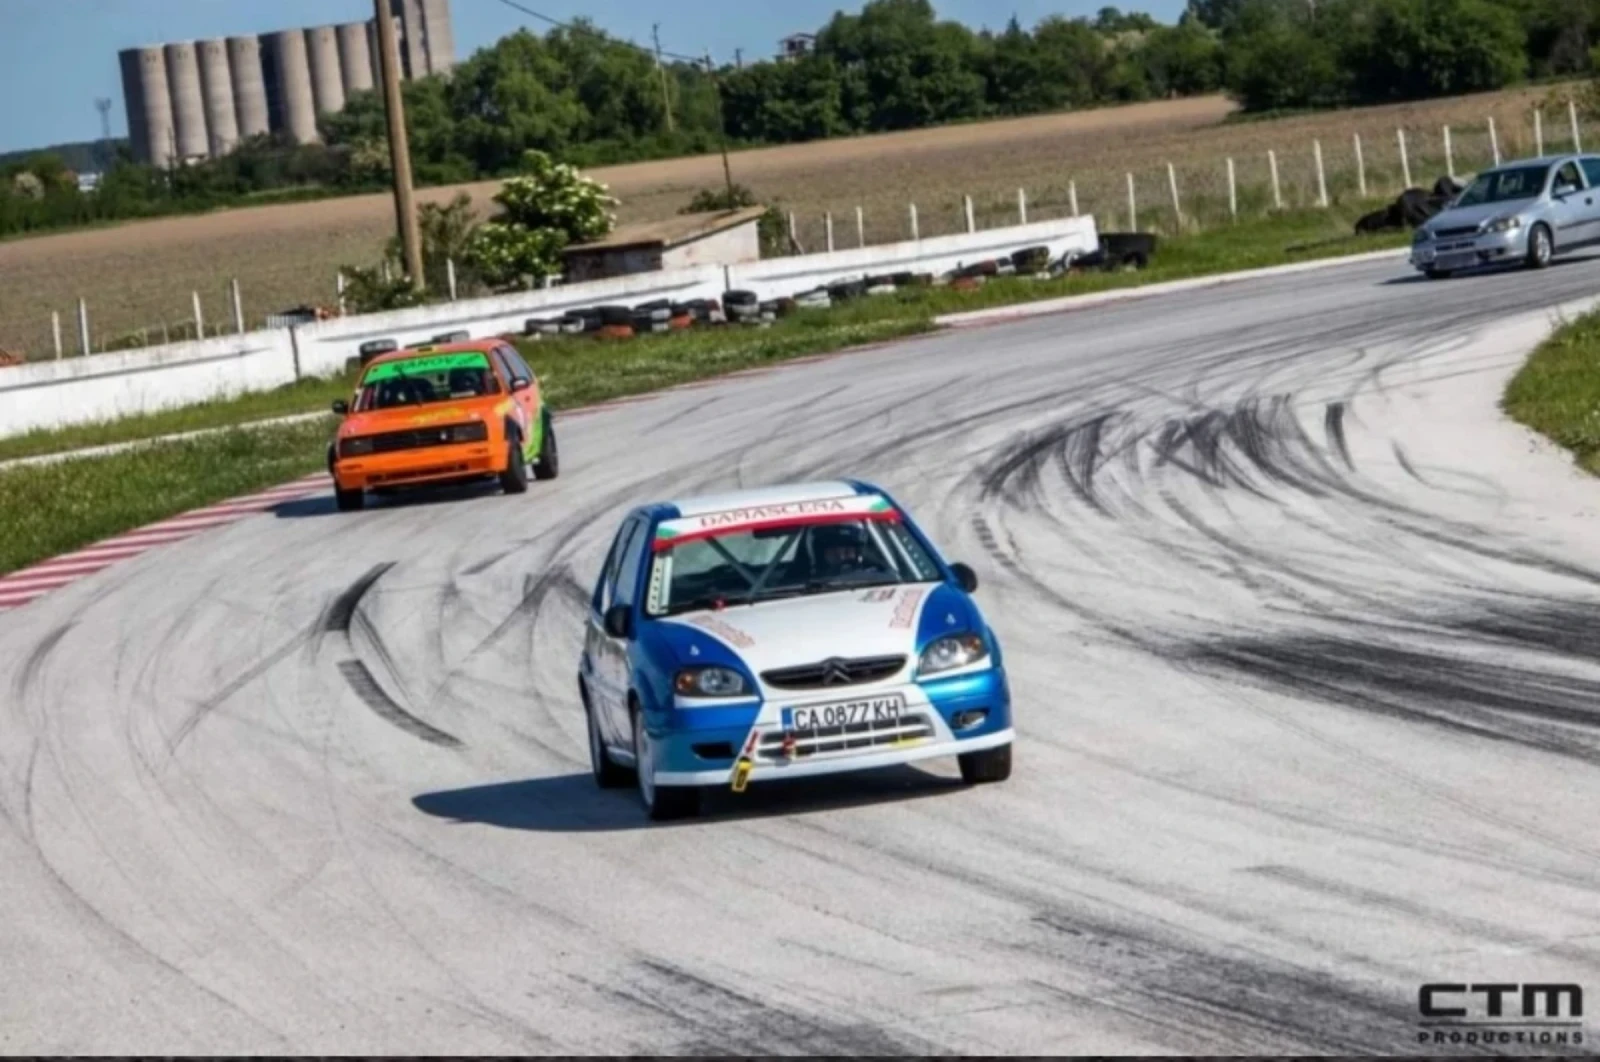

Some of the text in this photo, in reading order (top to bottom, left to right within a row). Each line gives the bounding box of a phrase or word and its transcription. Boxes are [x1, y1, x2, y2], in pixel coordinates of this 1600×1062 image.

[794, 700, 899, 731] CA 0877 KH
